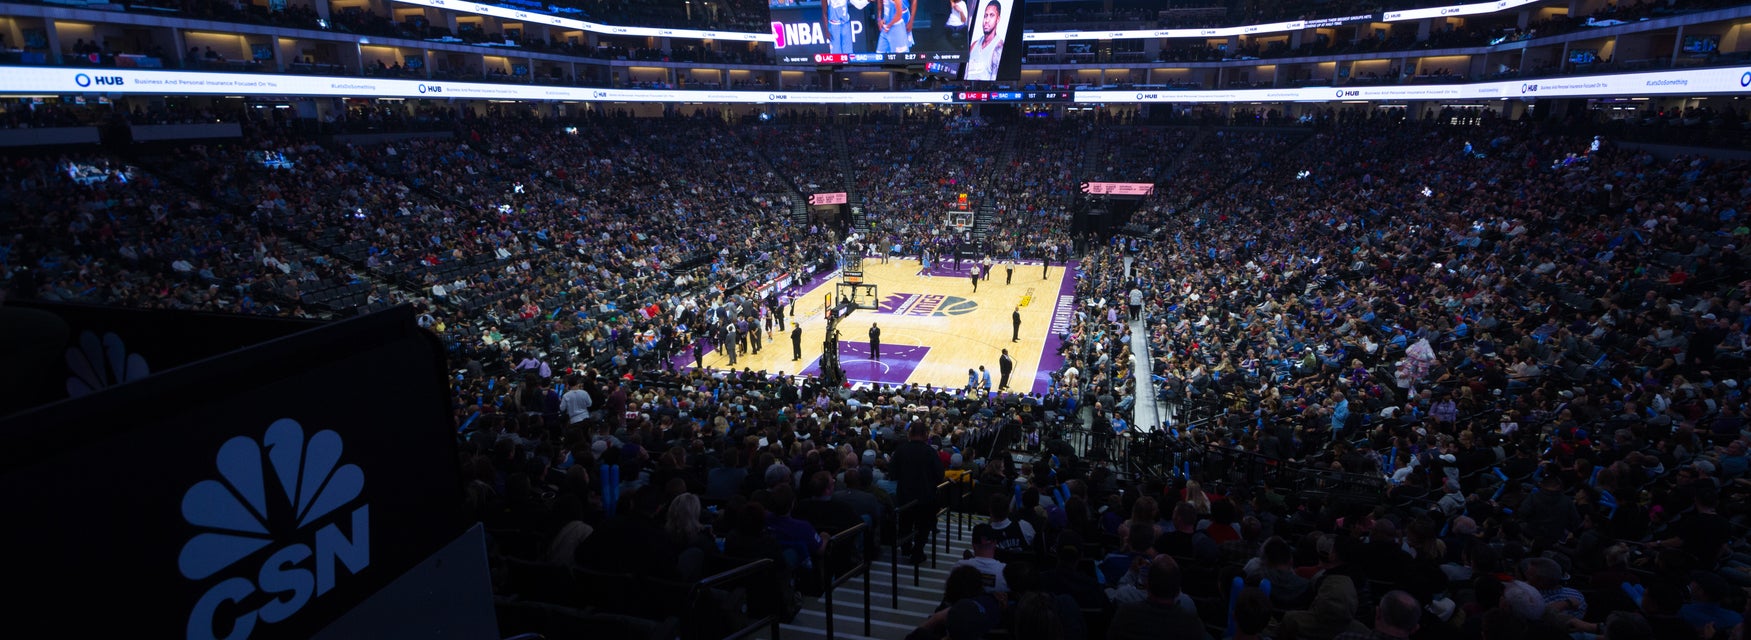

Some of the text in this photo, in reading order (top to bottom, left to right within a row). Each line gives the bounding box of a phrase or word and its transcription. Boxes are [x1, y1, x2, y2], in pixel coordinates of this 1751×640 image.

[785, 22, 825, 46] NBA
[95, 76, 124, 86] HUB
[907, 294, 945, 317] KINGS
[186, 503, 370, 640] CSN
